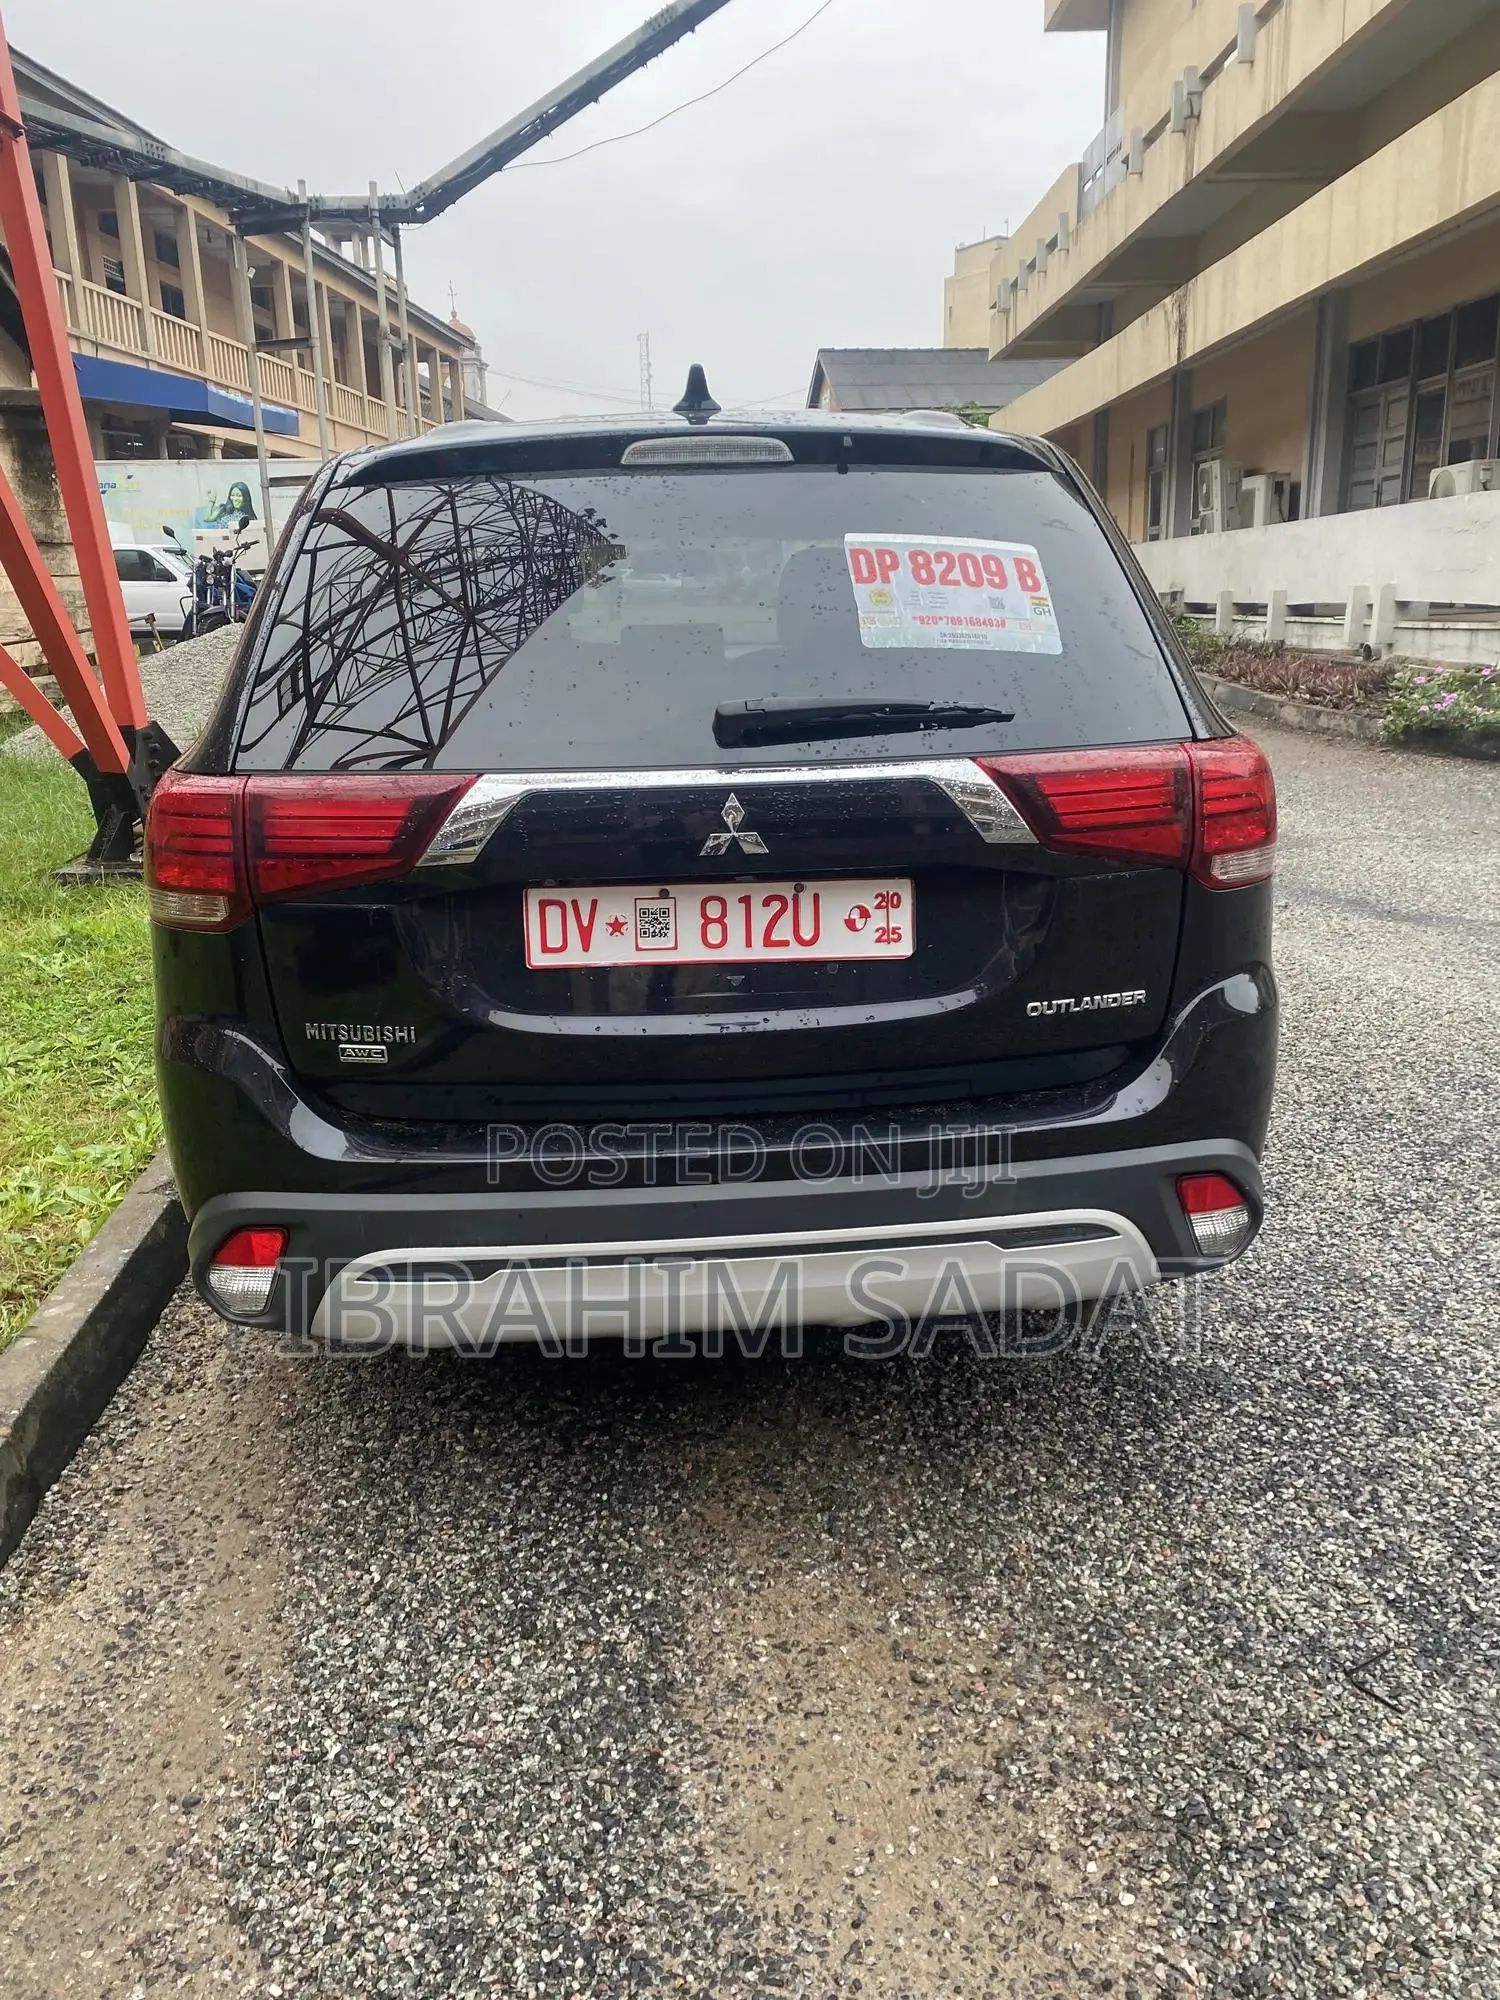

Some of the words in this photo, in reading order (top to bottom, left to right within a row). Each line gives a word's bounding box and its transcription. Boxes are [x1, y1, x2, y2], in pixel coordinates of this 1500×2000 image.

[850, 548, 899, 584] DP
[908, 549, 1009, 590] 8209
[1013, 557, 1043, 593] B
[1033, 607, 1052, 616] GH
[874, 892, 902, 909] 20
[538, 898, 599, 954] DV
[699, 893, 821, 950] 812U
[874, 926, 903, 944] 25
[1026, 989, 1146, 1017] OUTLANDER
[305, 1022, 416, 1043] MITSUBISHI
[343, 1048, 383, 1058] AWC
